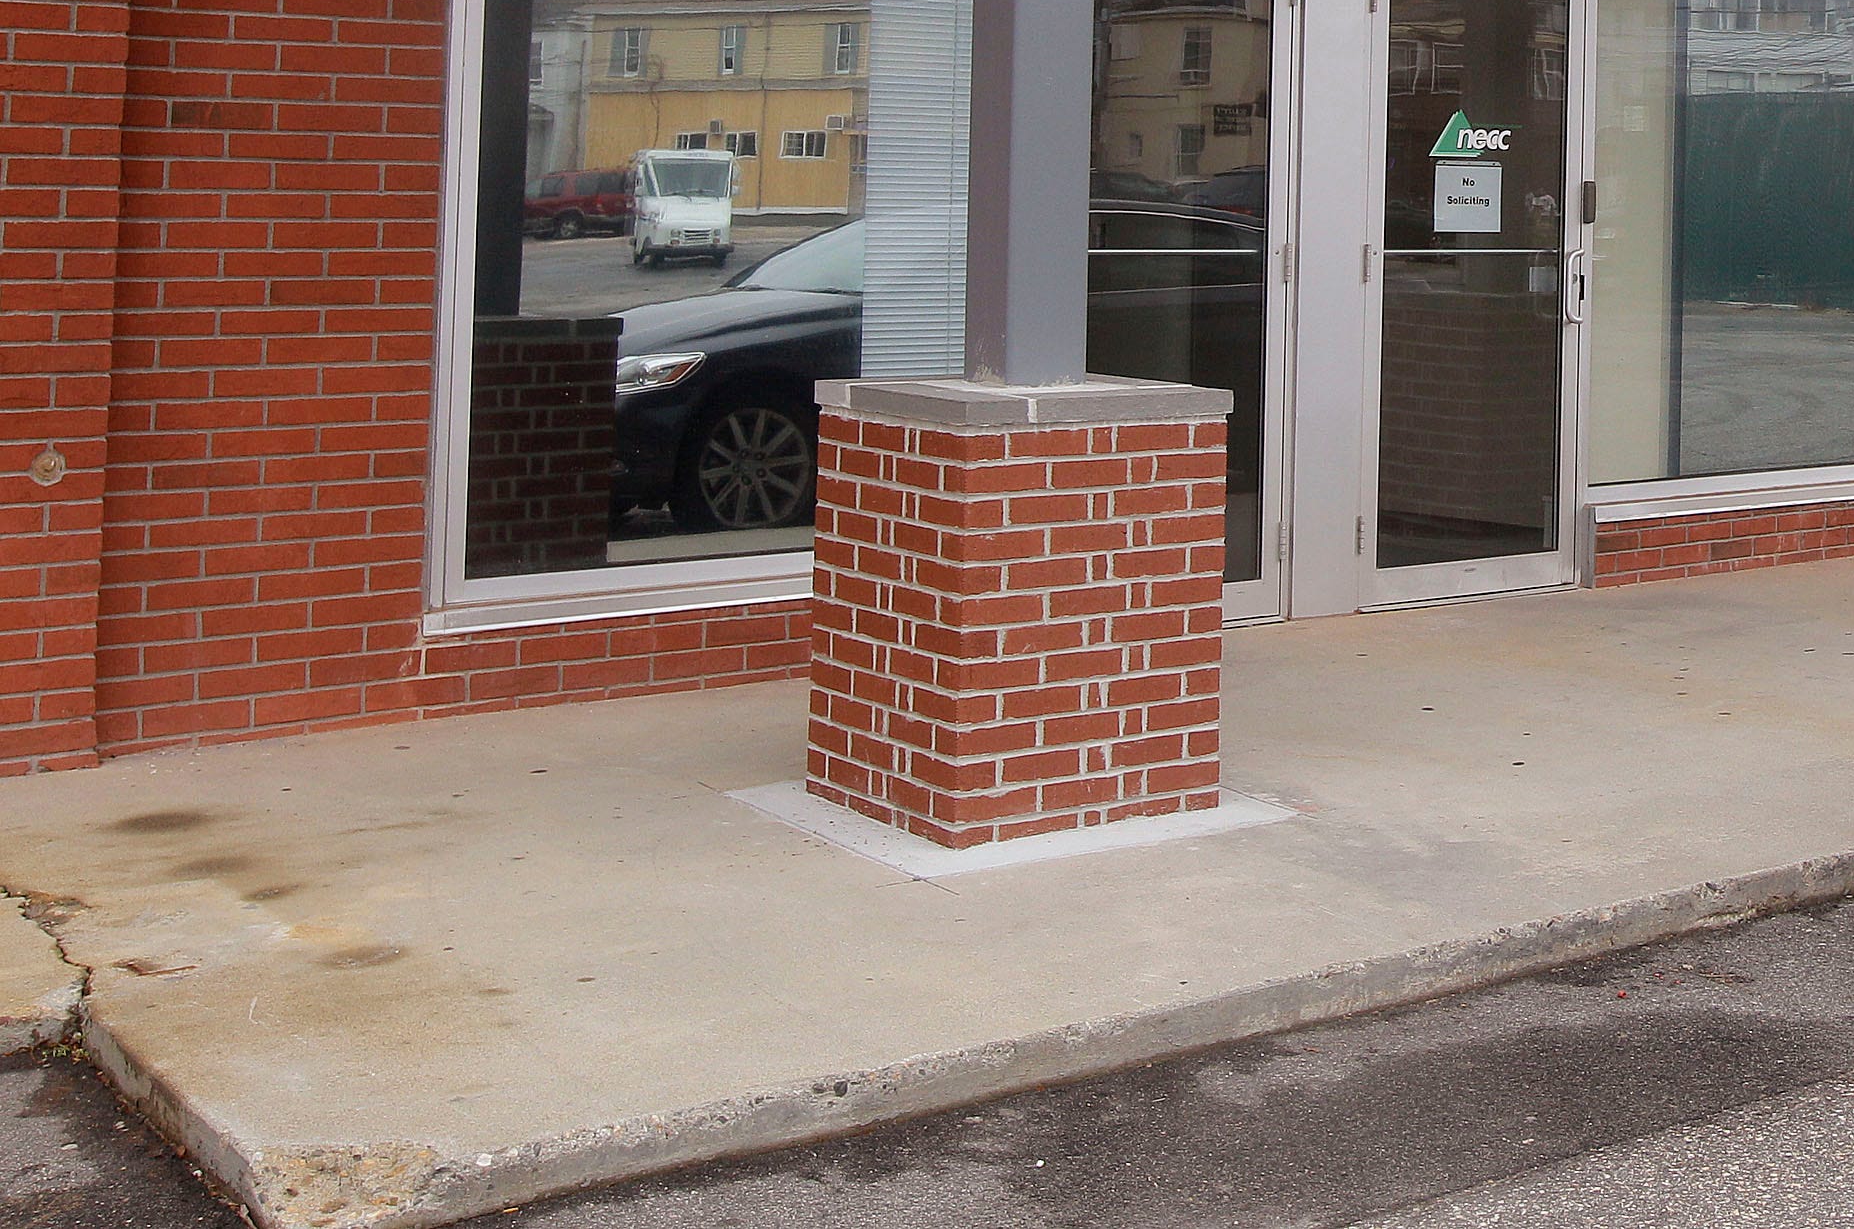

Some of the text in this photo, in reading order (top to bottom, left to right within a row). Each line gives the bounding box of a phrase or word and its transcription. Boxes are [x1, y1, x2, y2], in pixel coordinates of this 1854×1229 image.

[1457, 128, 1511, 150] necc
[1462, 178, 1475, 186] No
[1447, 196, 1490, 207] Soliciting
